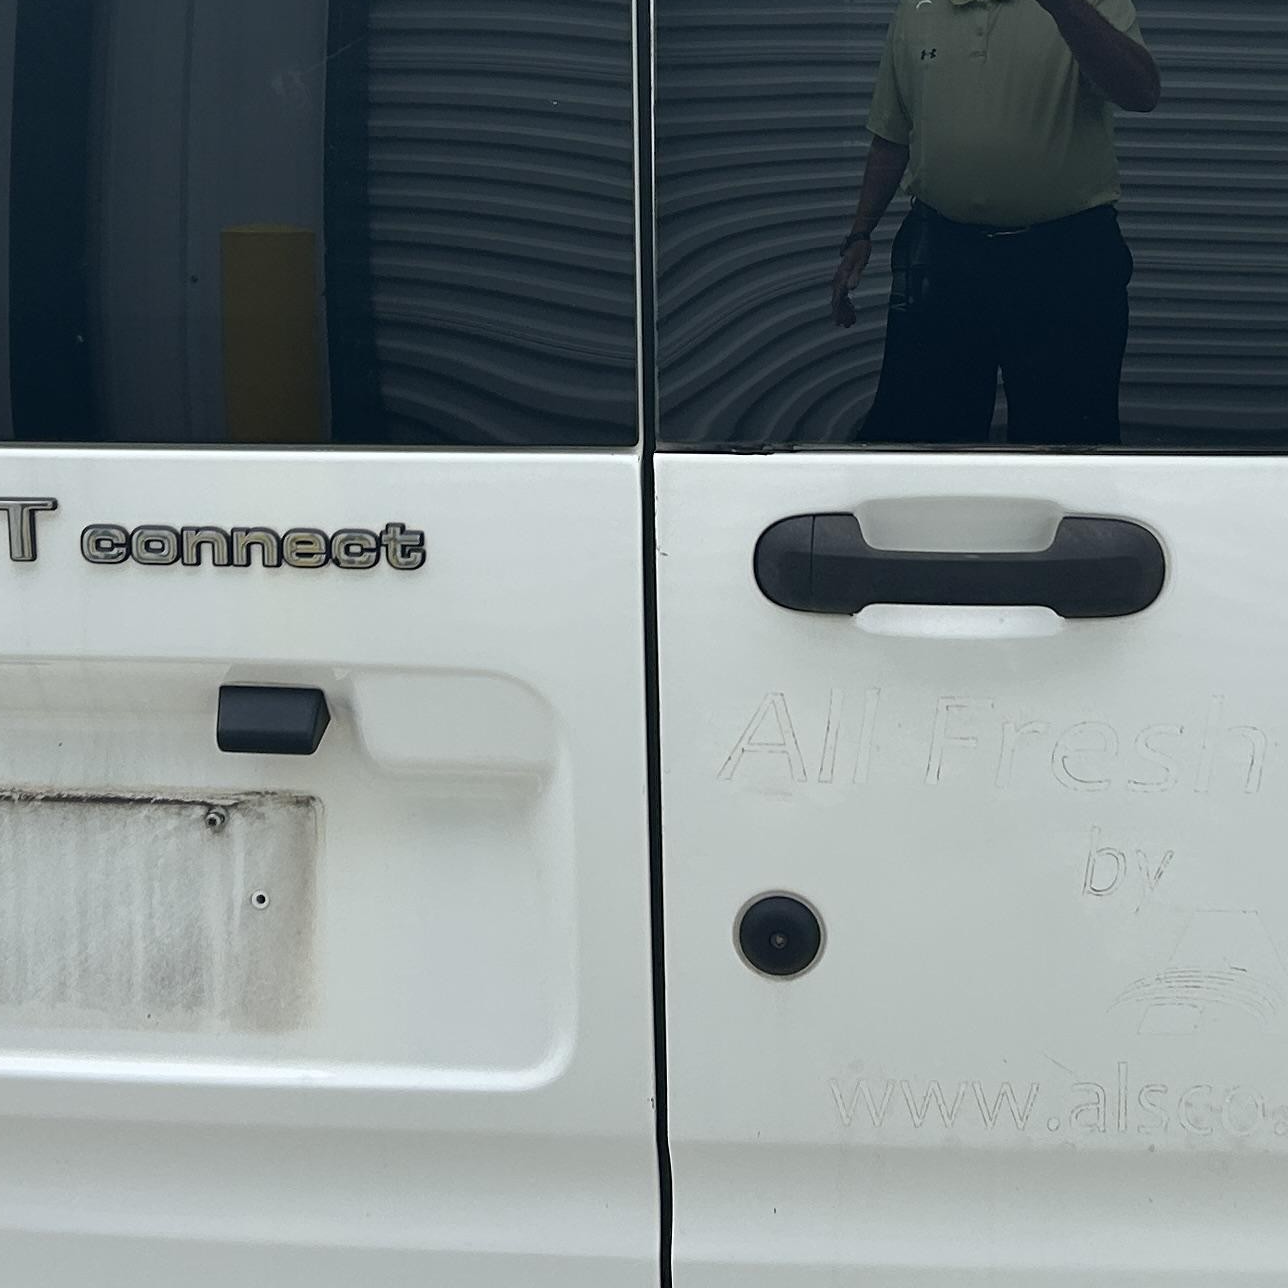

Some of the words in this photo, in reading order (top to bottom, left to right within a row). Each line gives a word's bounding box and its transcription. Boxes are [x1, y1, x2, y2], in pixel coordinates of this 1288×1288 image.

[80, 521, 427, 571] connect
[715, 687, 881, 784] All
[923, 695, 1269, 795] Fresh
[1082, 826, 1174, 913] by
